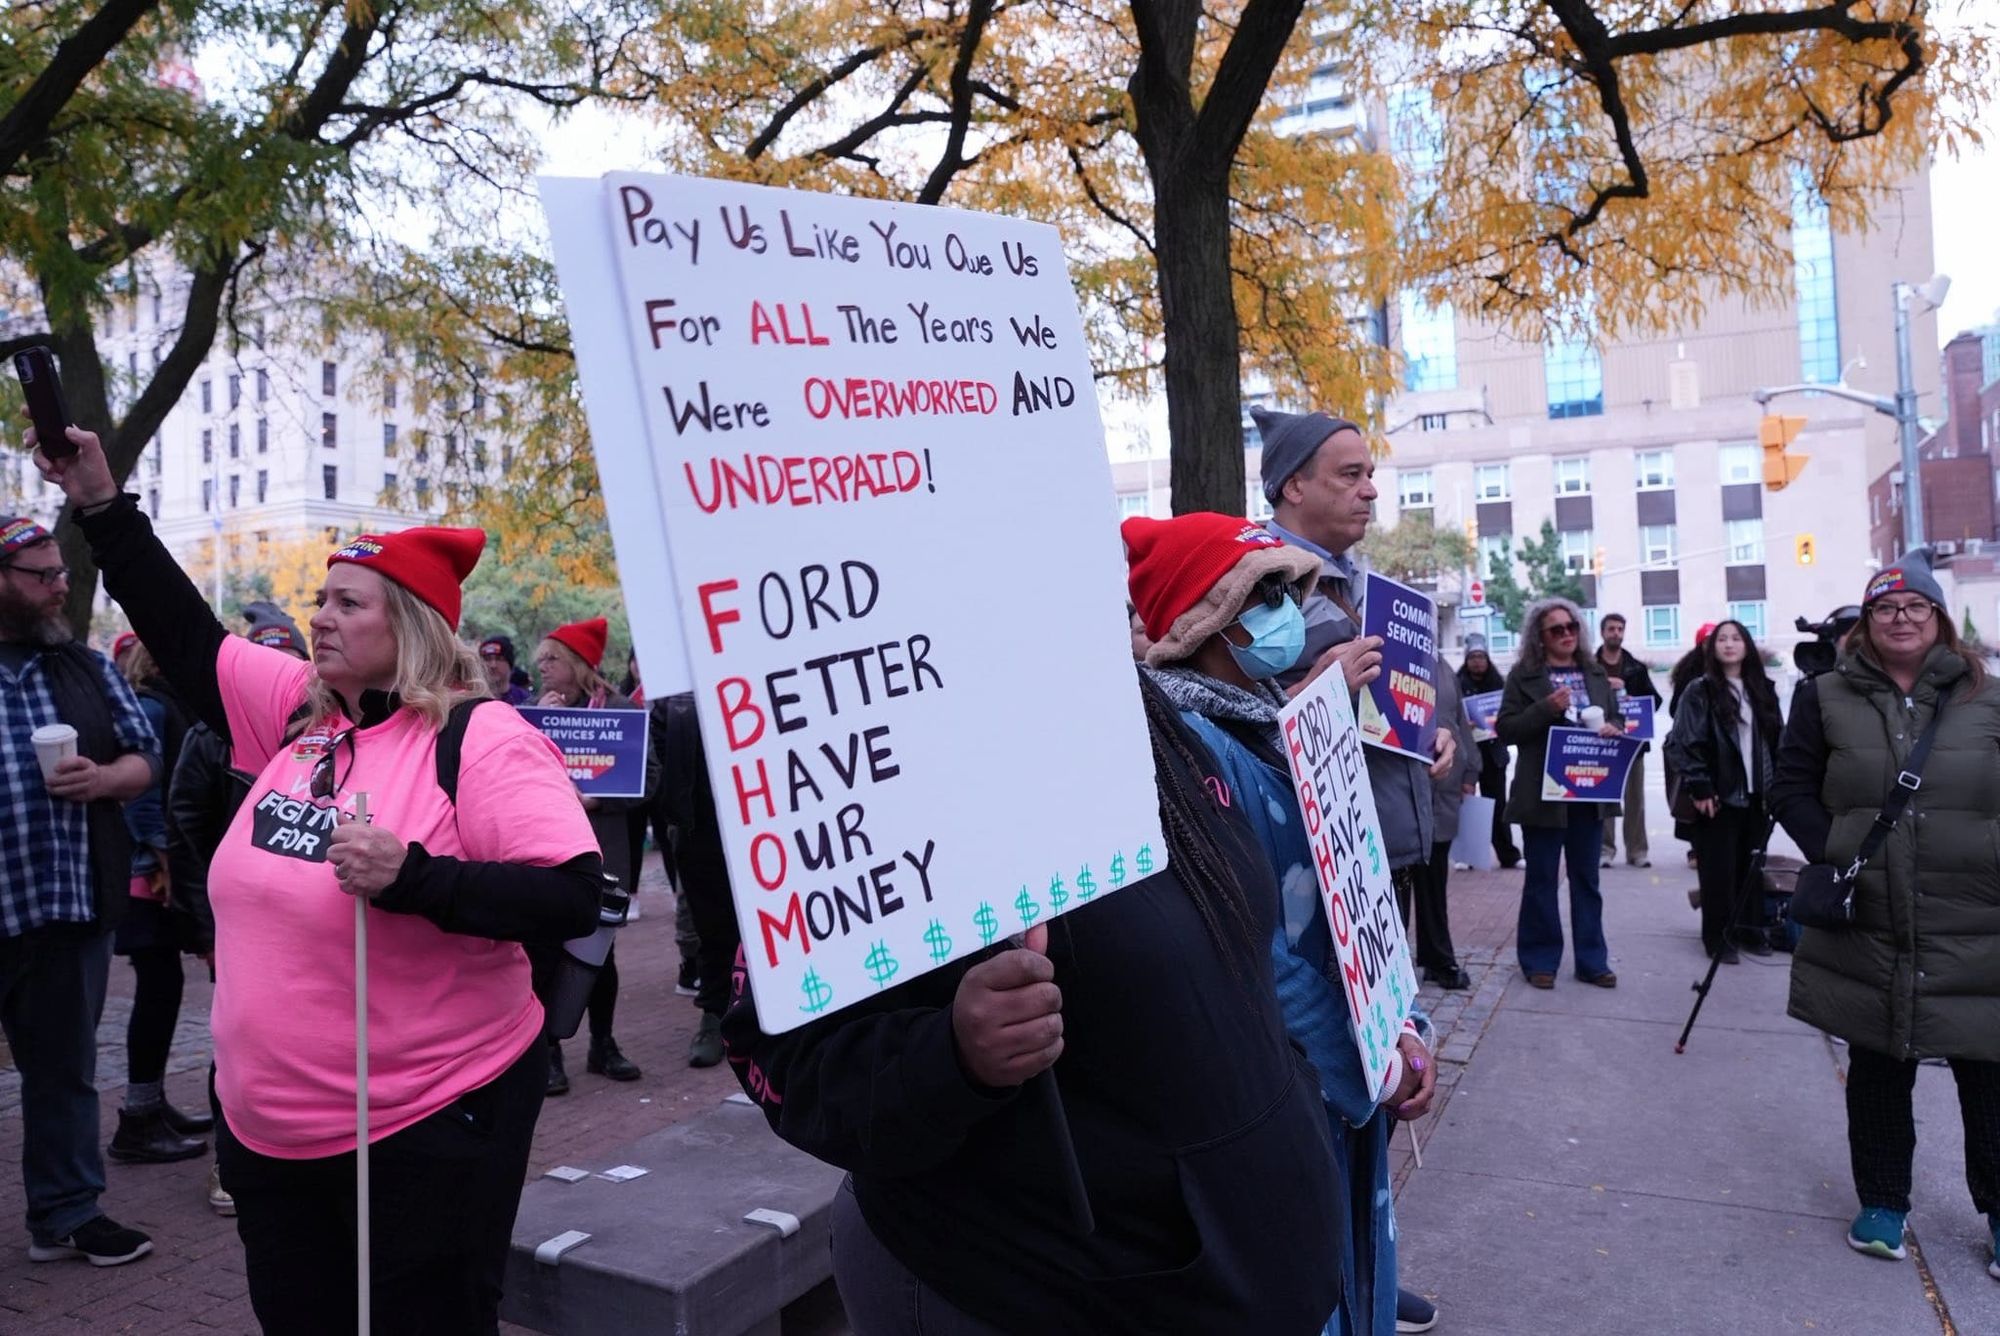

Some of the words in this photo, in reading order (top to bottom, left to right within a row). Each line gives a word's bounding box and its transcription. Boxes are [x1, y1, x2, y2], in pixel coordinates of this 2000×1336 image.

[619, 185, 699, 265] Pay
[720, 205, 768, 254] Us
[780, 209, 860, 263] Like
[869, 220, 932, 270] You
[945, 233, 993, 276] Owe
[1002, 241, 1040, 277] Us
[645, 298, 721, 350] For
[751, 300, 830, 345] ALL
[837, 305, 898, 344] The
[907, 302, 994, 344] Years
[1010, 314, 1057, 350] We
[663, 381, 770, 436] Were
[804, 377, 998, 420] OVERWORKED
[1012, 370, 1075, 416] AND
[684, 448, 936, 514] UNDERPAID!
[698, 560, 879, 654] FORD
[1387, 621, 1432, 655] SERVICES
[1393, 599, 1435, 632] COMMU
[542, 716, 620, 729] COMMUNITY
[716, 634, 943, 752] BETTER
[1403, 701, 1425, 727] FOR
[565, 755, 615, 767] HTING
[598, 731, 623, 741] ARE
[1285, 696, 1332, 782] FORD
[1562, 745, 1599, 756] SERVICES
[1600, 748, 1619, 757] ARE
[1566, 735, 1620, 747] COMMUNITY
[732, 726, 900, 825] HAVE
[1300, 726, 1364, 837] BETTER
[267, 826, 321, 856] FOR
[750, 803, 873, 891] OUR
[1315, 791, 1367, 893] HAVE
[757, 839, 935, 969] MONEY
[1332, 859, 1370, 947] OUR
[1344, 880, 1400, 1026] MONEY
